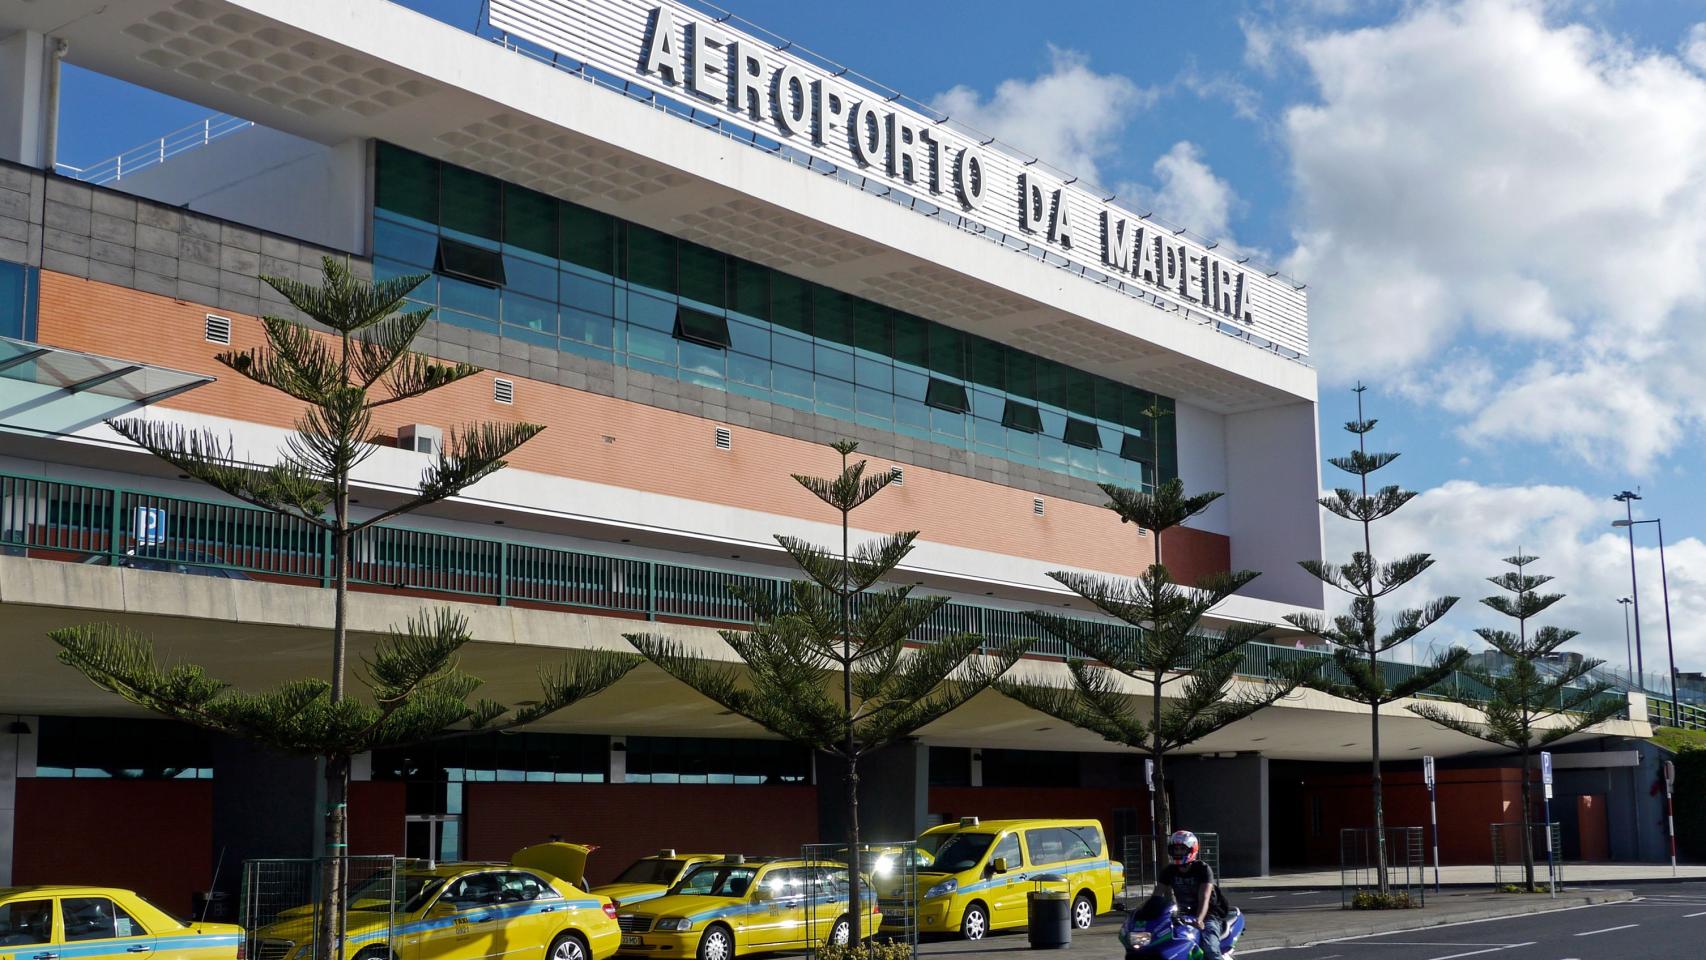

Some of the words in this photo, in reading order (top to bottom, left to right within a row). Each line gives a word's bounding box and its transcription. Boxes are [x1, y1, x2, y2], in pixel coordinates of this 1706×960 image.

[645, 6, 986, 210] AEROPORTO
[1018, 173, 1075, 248] DA
[1101, 211, 1256, 324] MADEIRA
[140, 510, 157, 538] P
[1544, 755, 1549, 774] P
[453, 917, 469, 926] TAXI
